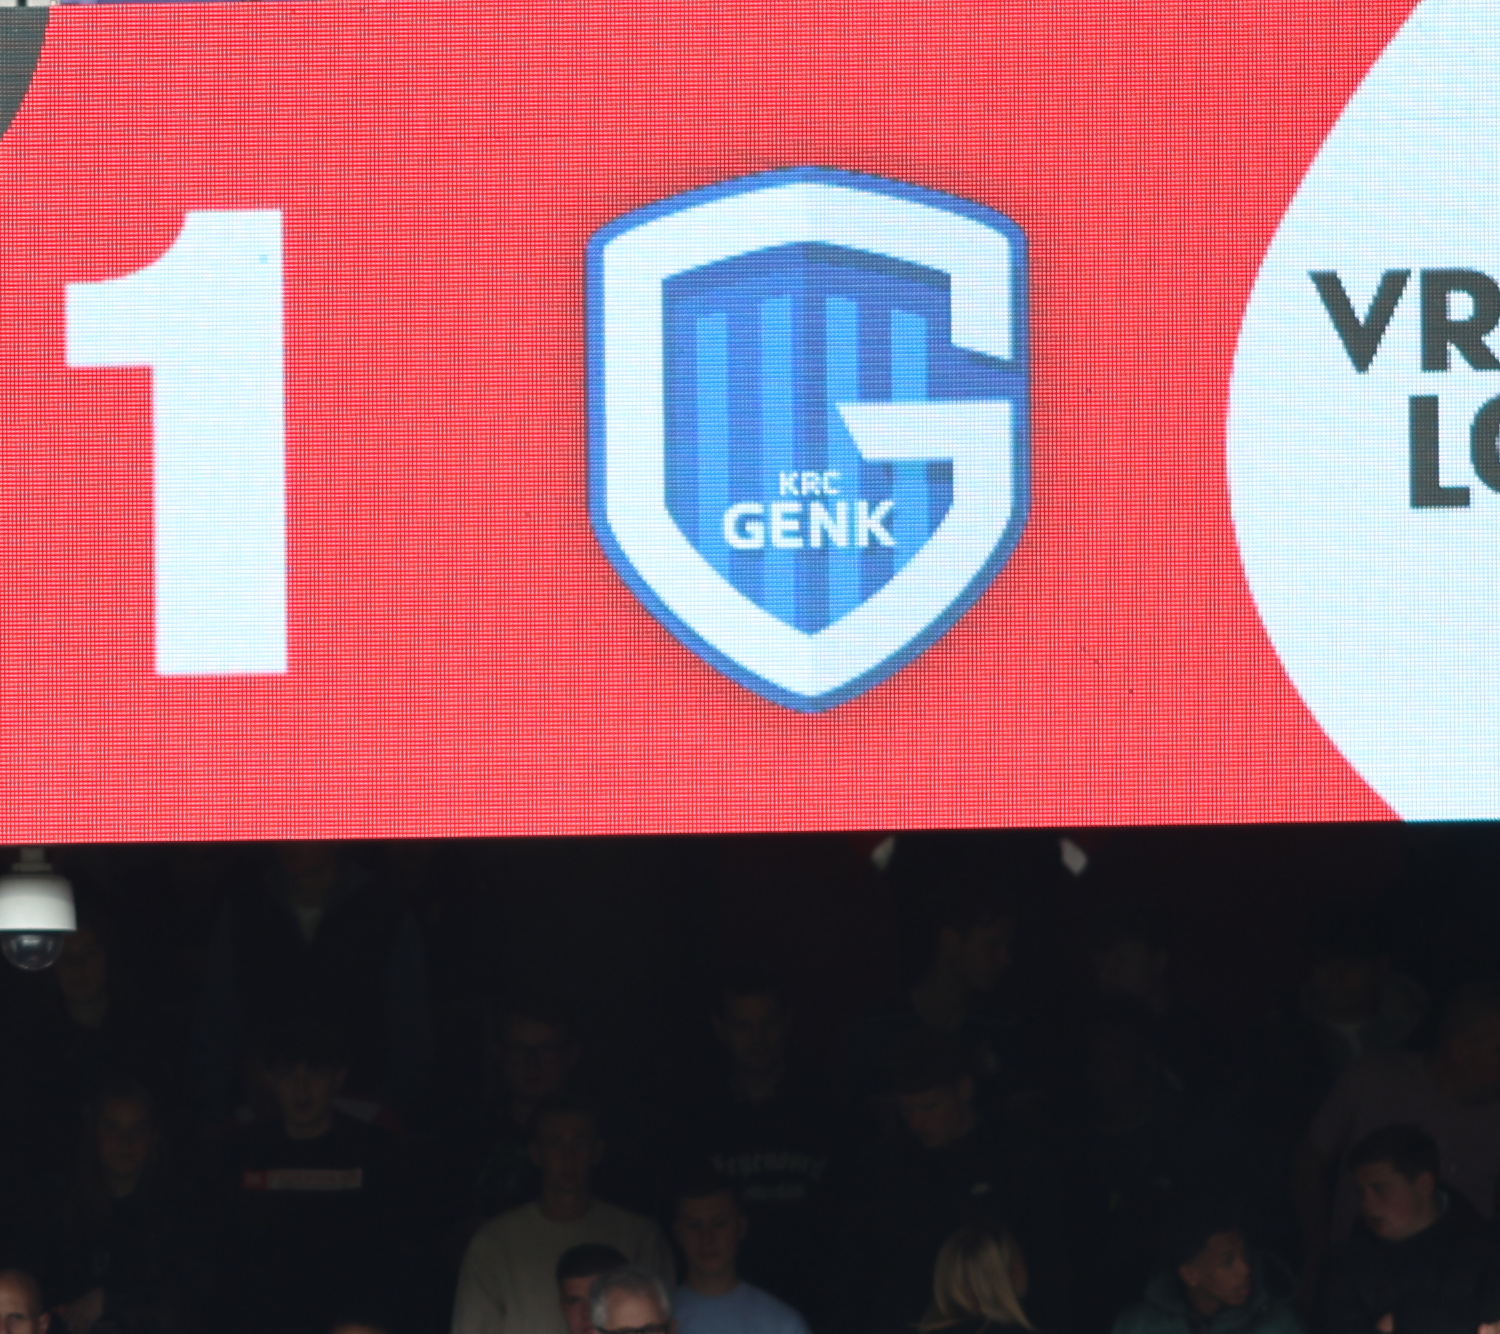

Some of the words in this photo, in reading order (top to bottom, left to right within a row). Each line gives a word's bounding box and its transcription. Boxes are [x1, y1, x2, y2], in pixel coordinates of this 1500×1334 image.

[63, 207, 289, 677] 1
[778, 470, 840, 496] KRC
[722, 500, 897, 550] GENK
